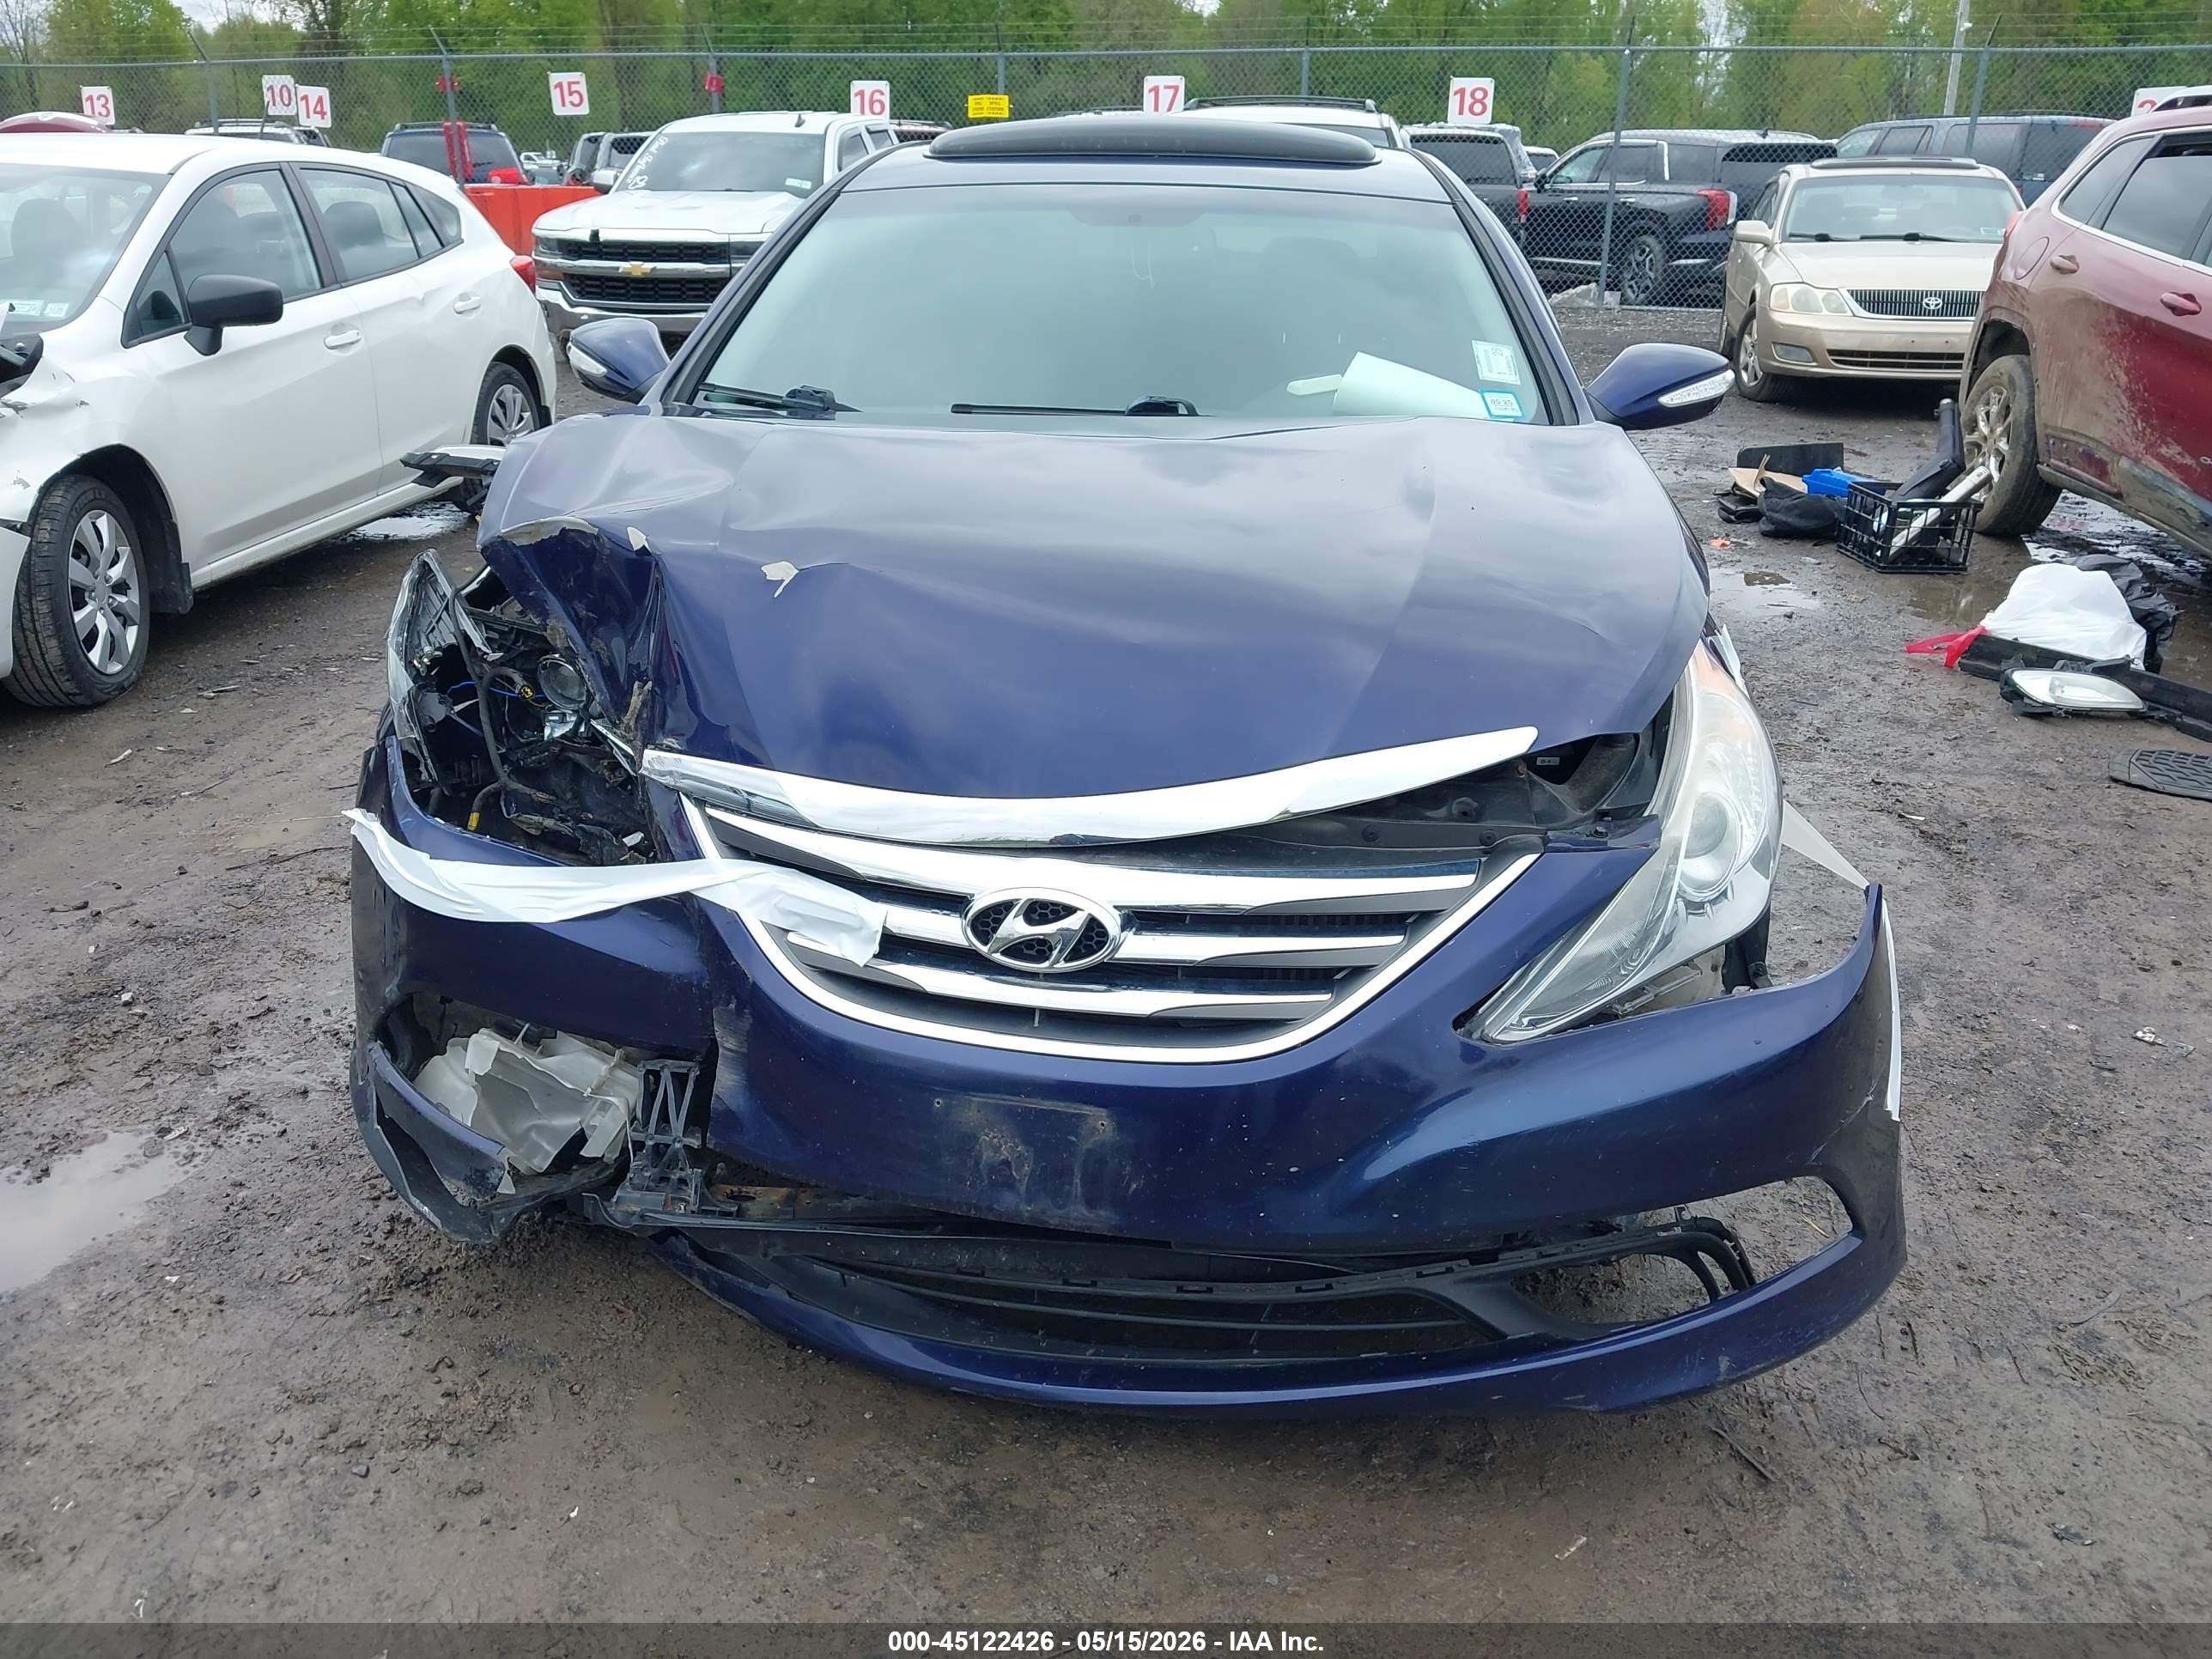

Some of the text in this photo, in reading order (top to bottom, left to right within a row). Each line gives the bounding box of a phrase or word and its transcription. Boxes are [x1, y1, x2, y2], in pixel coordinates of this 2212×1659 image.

[85, 94, 111, 118] 13
[267, 84, 292, 107] 10
[300, 94, 327, 120] 14
[554, 81, 584, 107] 15
[854, 88, 886, 116] 16
[1148, 84, 1180, 112] 17
[1453, 87, 1488, 117] 18
